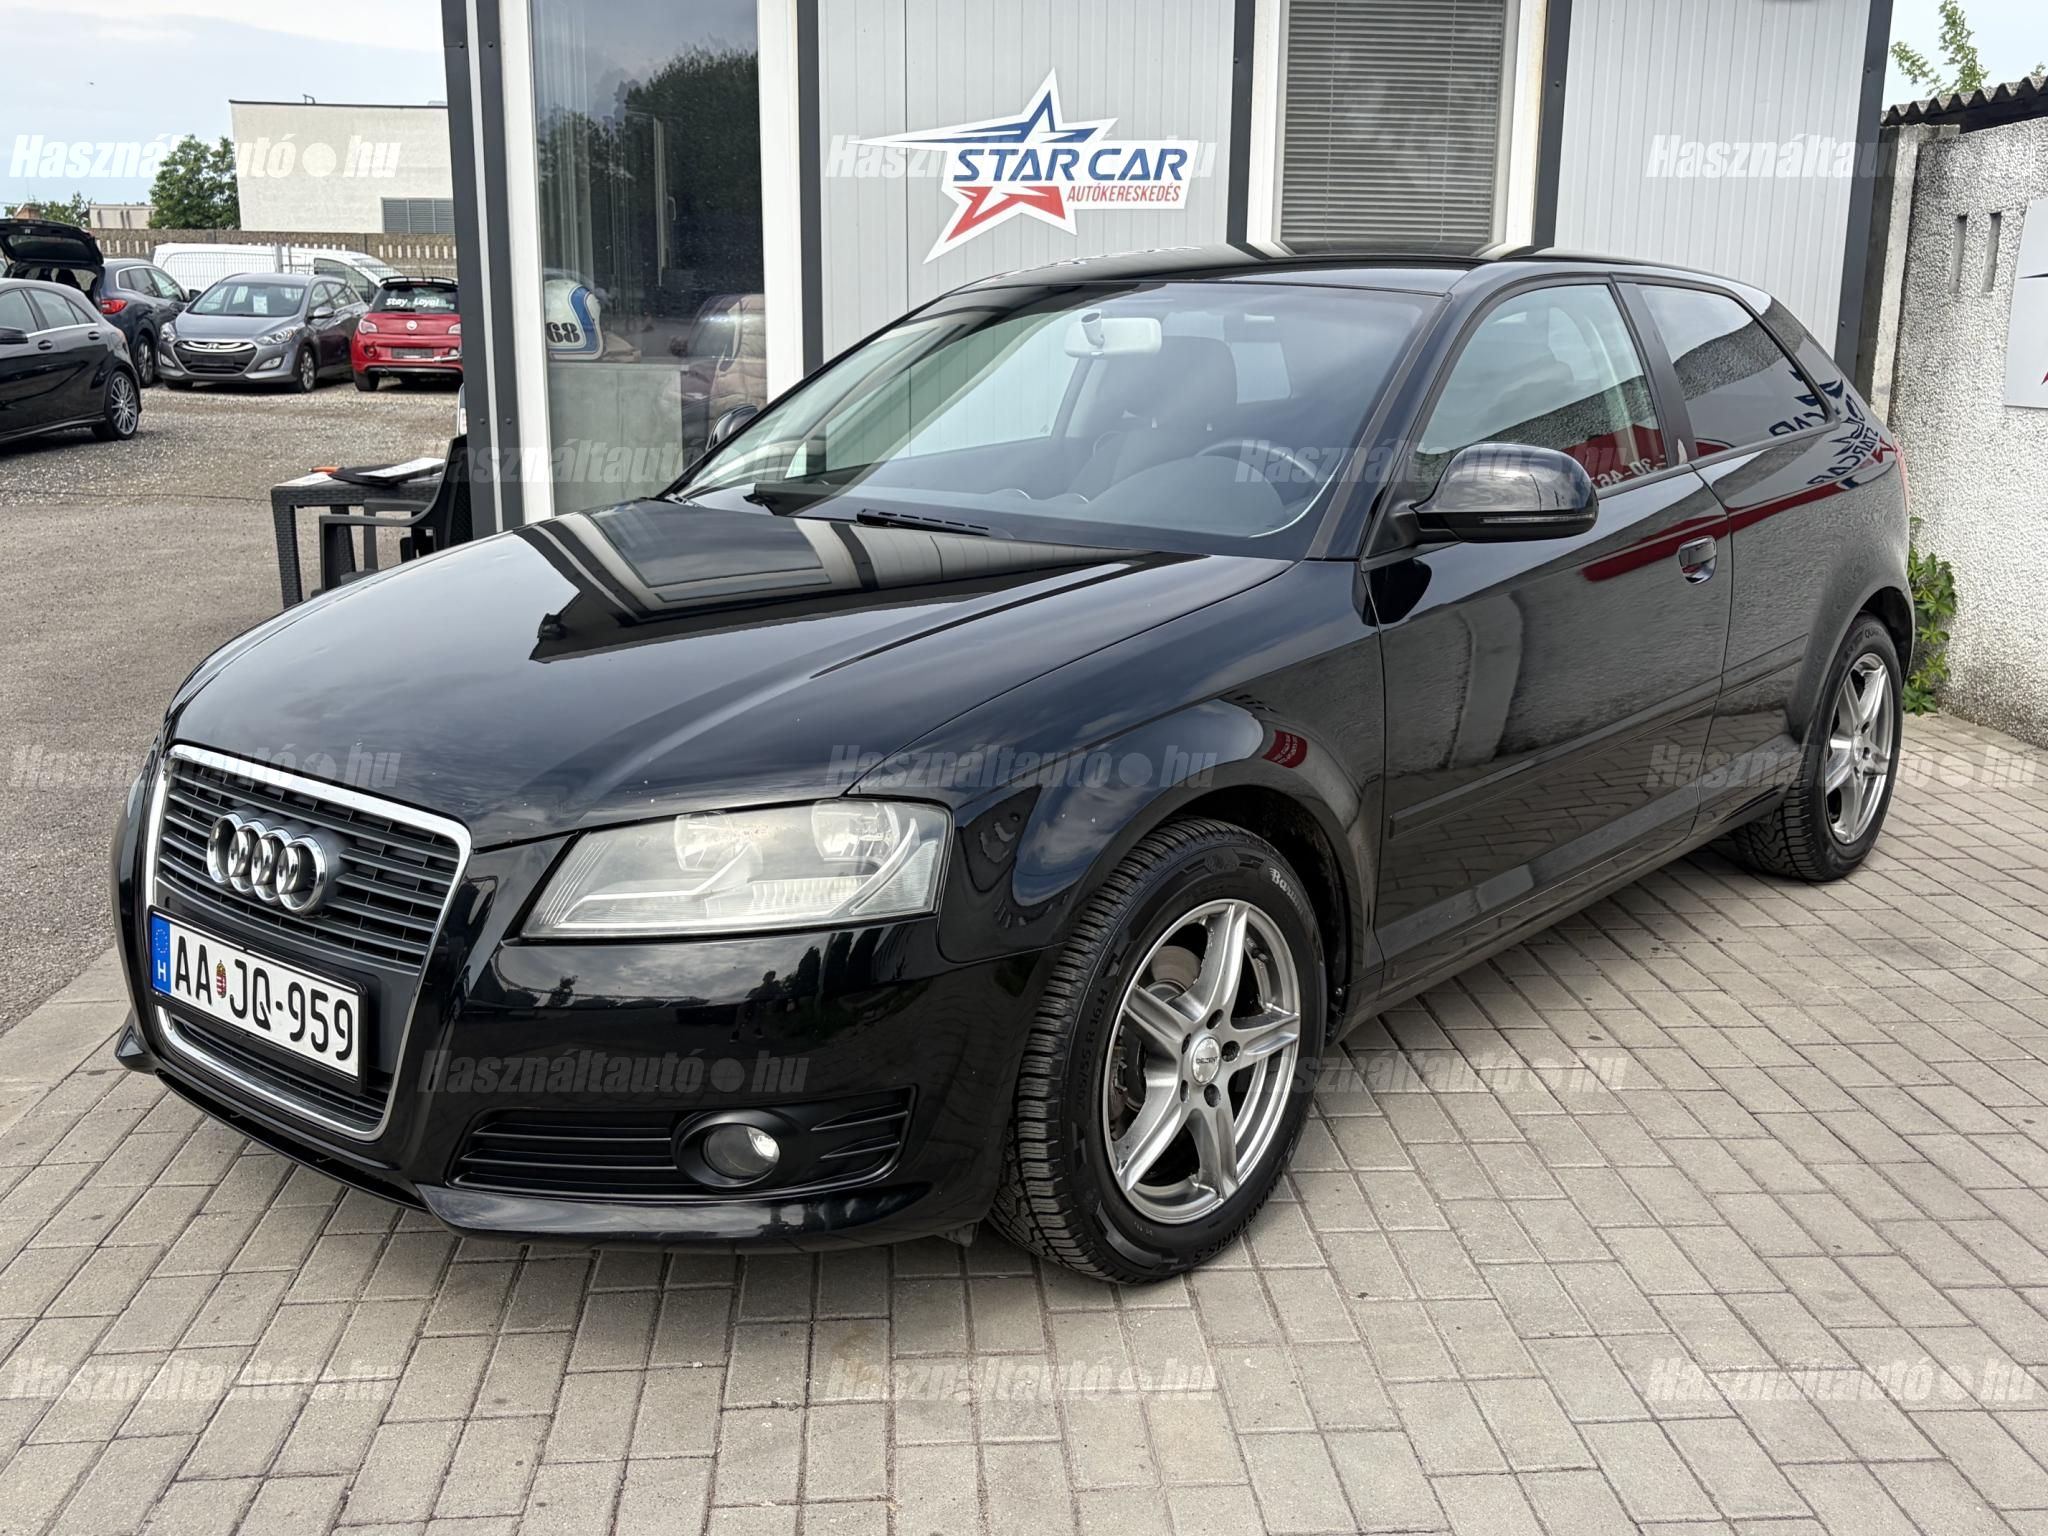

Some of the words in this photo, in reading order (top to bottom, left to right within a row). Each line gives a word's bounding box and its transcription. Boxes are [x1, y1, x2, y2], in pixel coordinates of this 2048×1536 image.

[953, 148, 1080, 182] STAR
[1087, 148, 1188, 182] CAR
[1066, 183, 1181, 203] AUTÓKERESKEDÉS
[546, 321, 581, 343] 68
[157, 959, 167, 982] H
[175, 935, 212, 1006] AA
